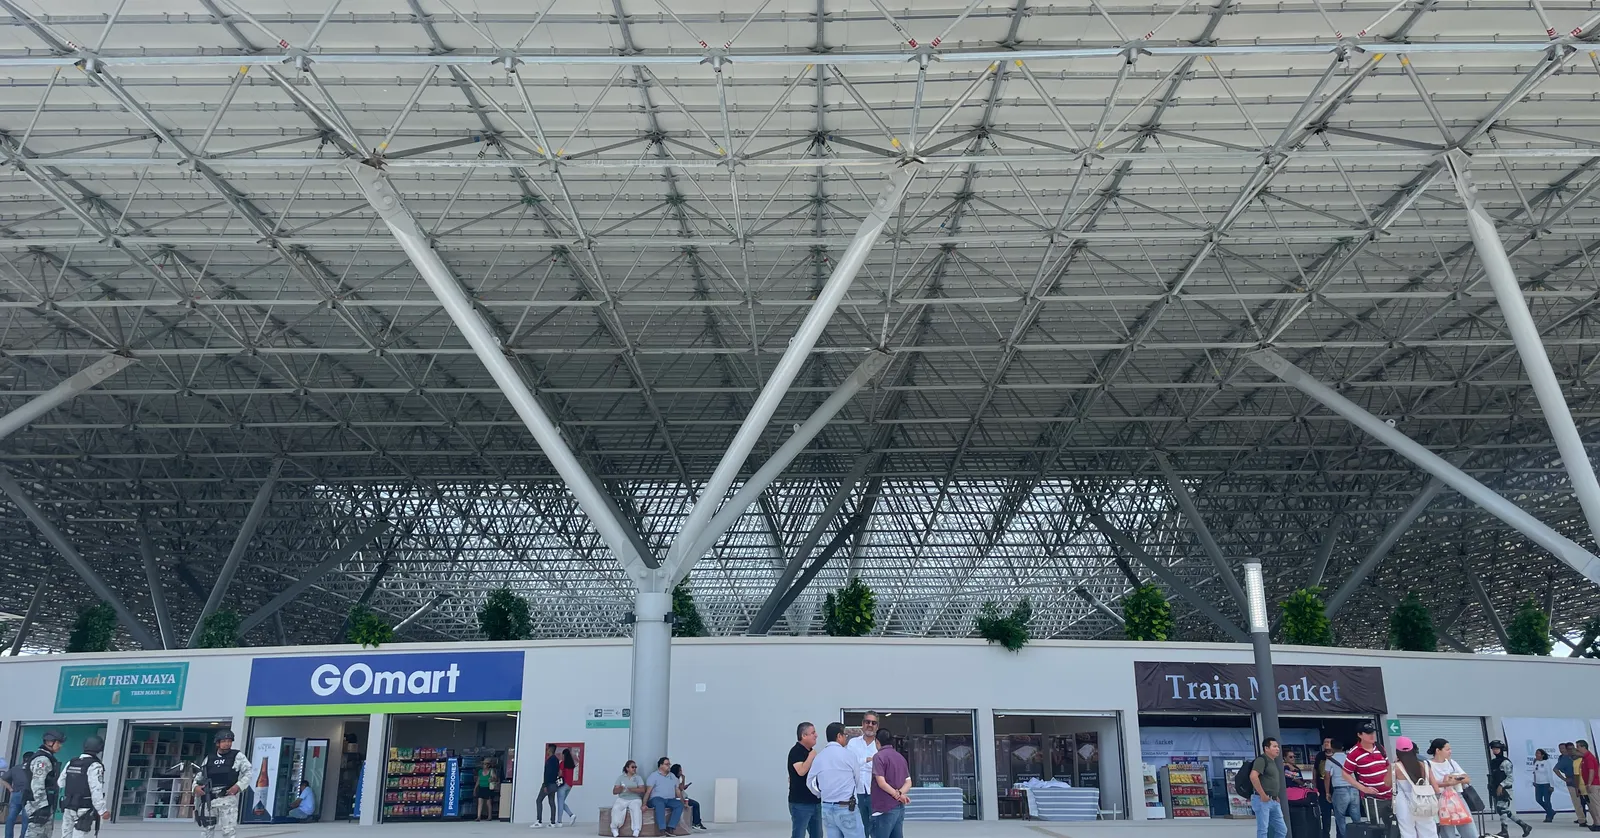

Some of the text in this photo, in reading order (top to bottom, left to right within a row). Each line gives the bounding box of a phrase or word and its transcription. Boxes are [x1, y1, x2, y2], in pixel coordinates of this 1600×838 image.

[70, 673, 176, 687] Tienda TREN MAYA
[310, 662, 460, 697] GOmart
[1165, 674, 1241, 700] Train
[448, 762, 457, 810] PROMOCIONES
